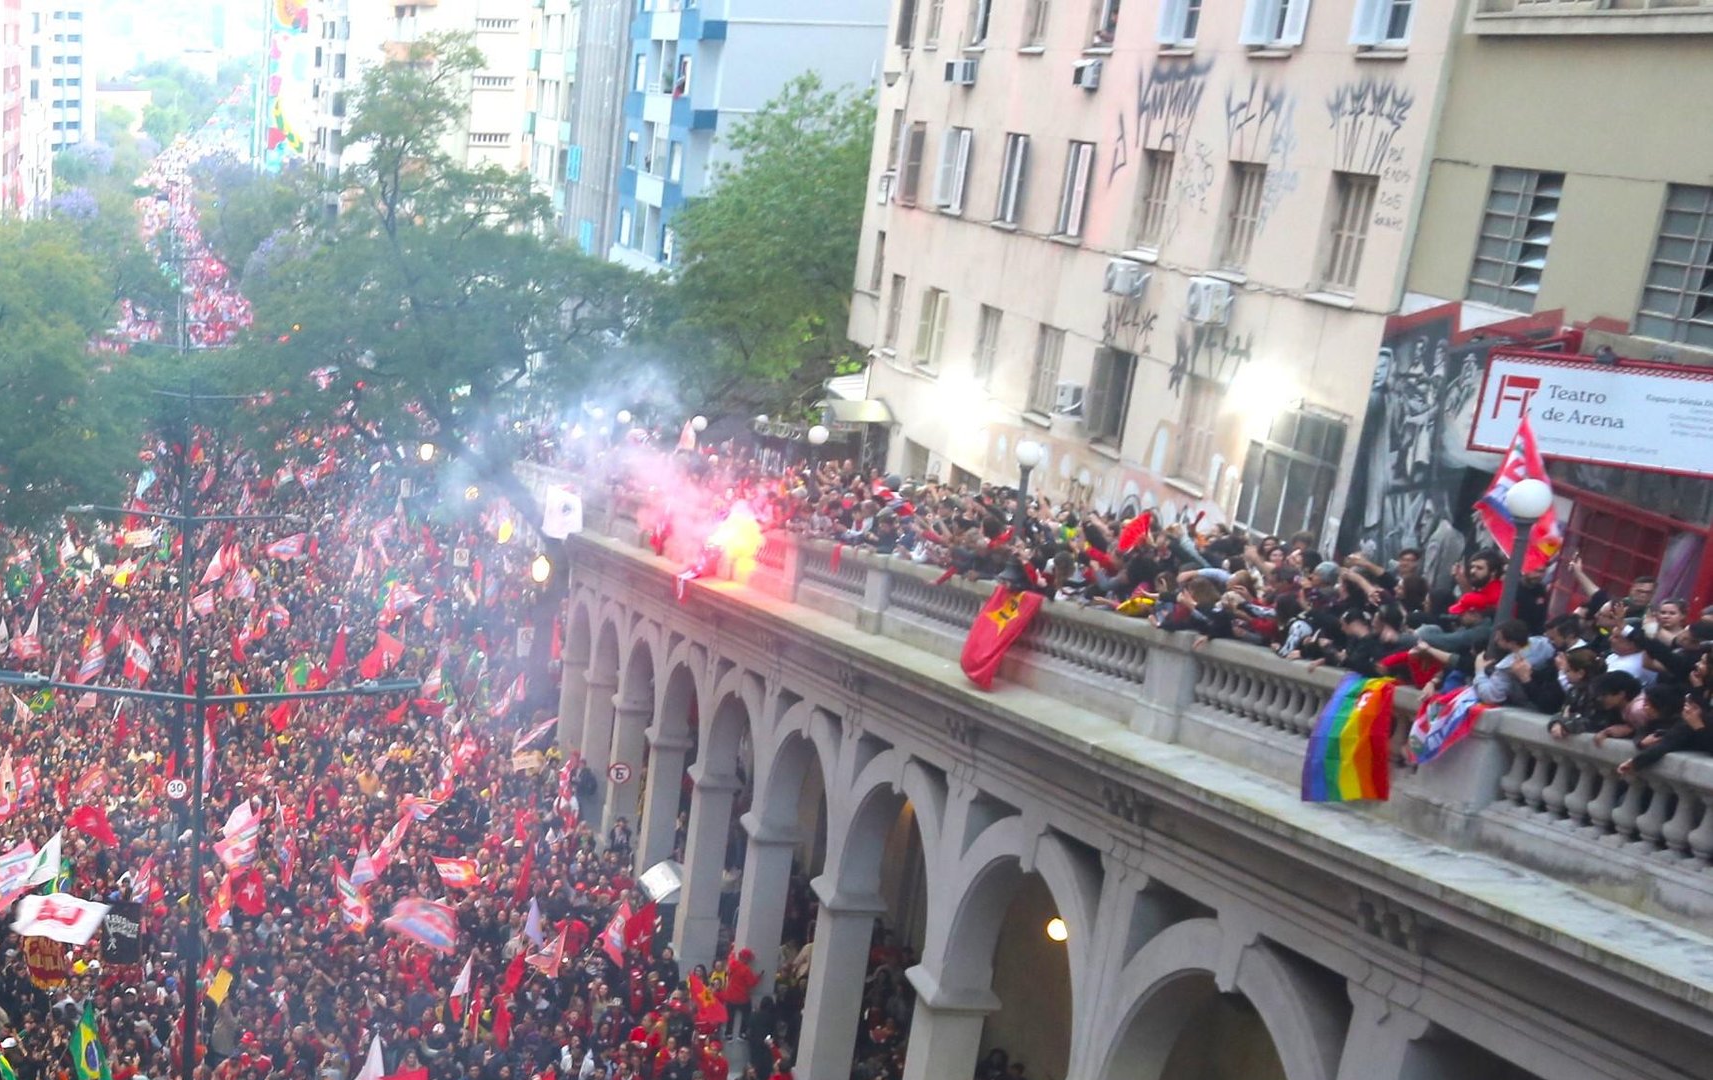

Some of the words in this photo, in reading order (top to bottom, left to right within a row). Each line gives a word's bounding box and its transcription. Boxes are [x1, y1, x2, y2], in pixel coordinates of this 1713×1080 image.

[1549, 384, 1607, 405] Teatro
[1541, 407, 1565, 422] de
[1567, 409, 1625, 429] Arena
[169, 782, 184, 793] 30
